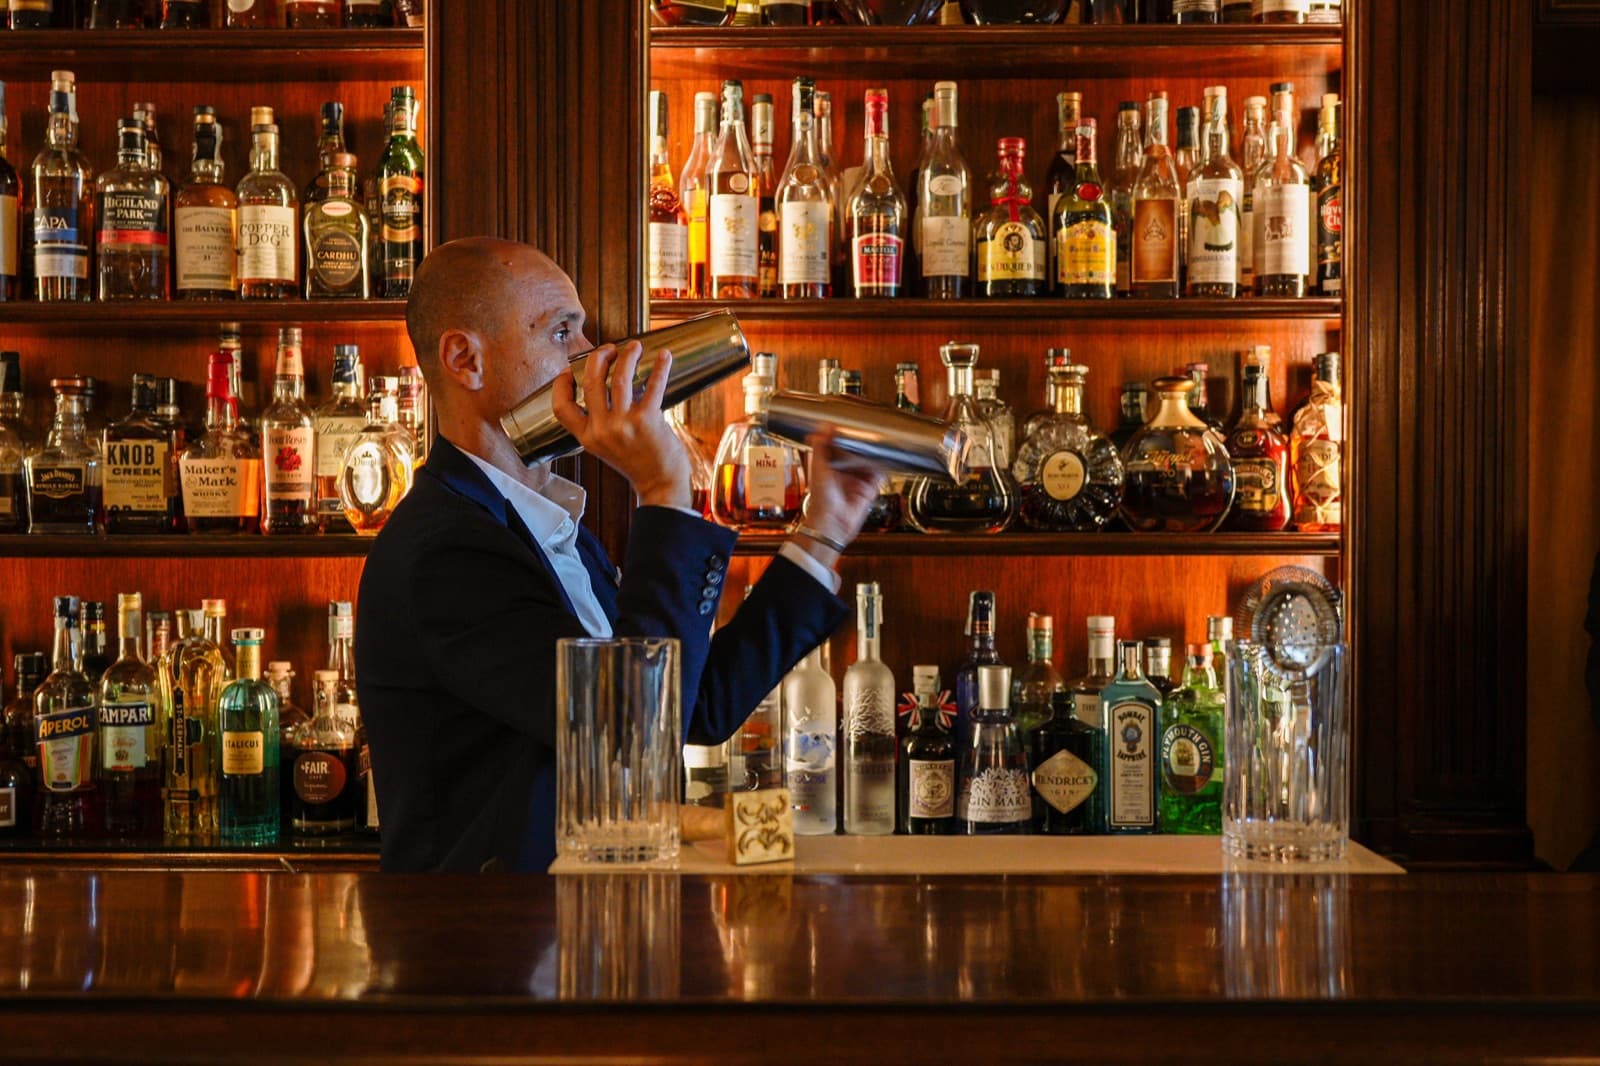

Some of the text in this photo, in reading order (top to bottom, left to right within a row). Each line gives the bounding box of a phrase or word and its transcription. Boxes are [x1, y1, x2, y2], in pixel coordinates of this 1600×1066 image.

[104, 197, 158, 210] HIGHLAND
[116, 209, 145, 219] PARK
[240, 223, 290, 237] COPPER
[249, 233, 281, 246] DOG
[317, 251, 357, 261] CARDHU
[107, 444, 155, 466] KNOB
[185, 465, 237, 475] Maker's
[756, 459, 777, 468] HINE
[112, 467, 162, 476] CREEK
[1117, 711, 1146, 723] BOMBAY
[39, 715, 89, 738] APEROL
[225, 740, 259, 749] ITALICUS
[1162, 727, 1211, 763] PLYMOUTH GIN
[1116, 749, 1147, 762] SAPPHIRE
[304, 761, 328, 774] FAIR
